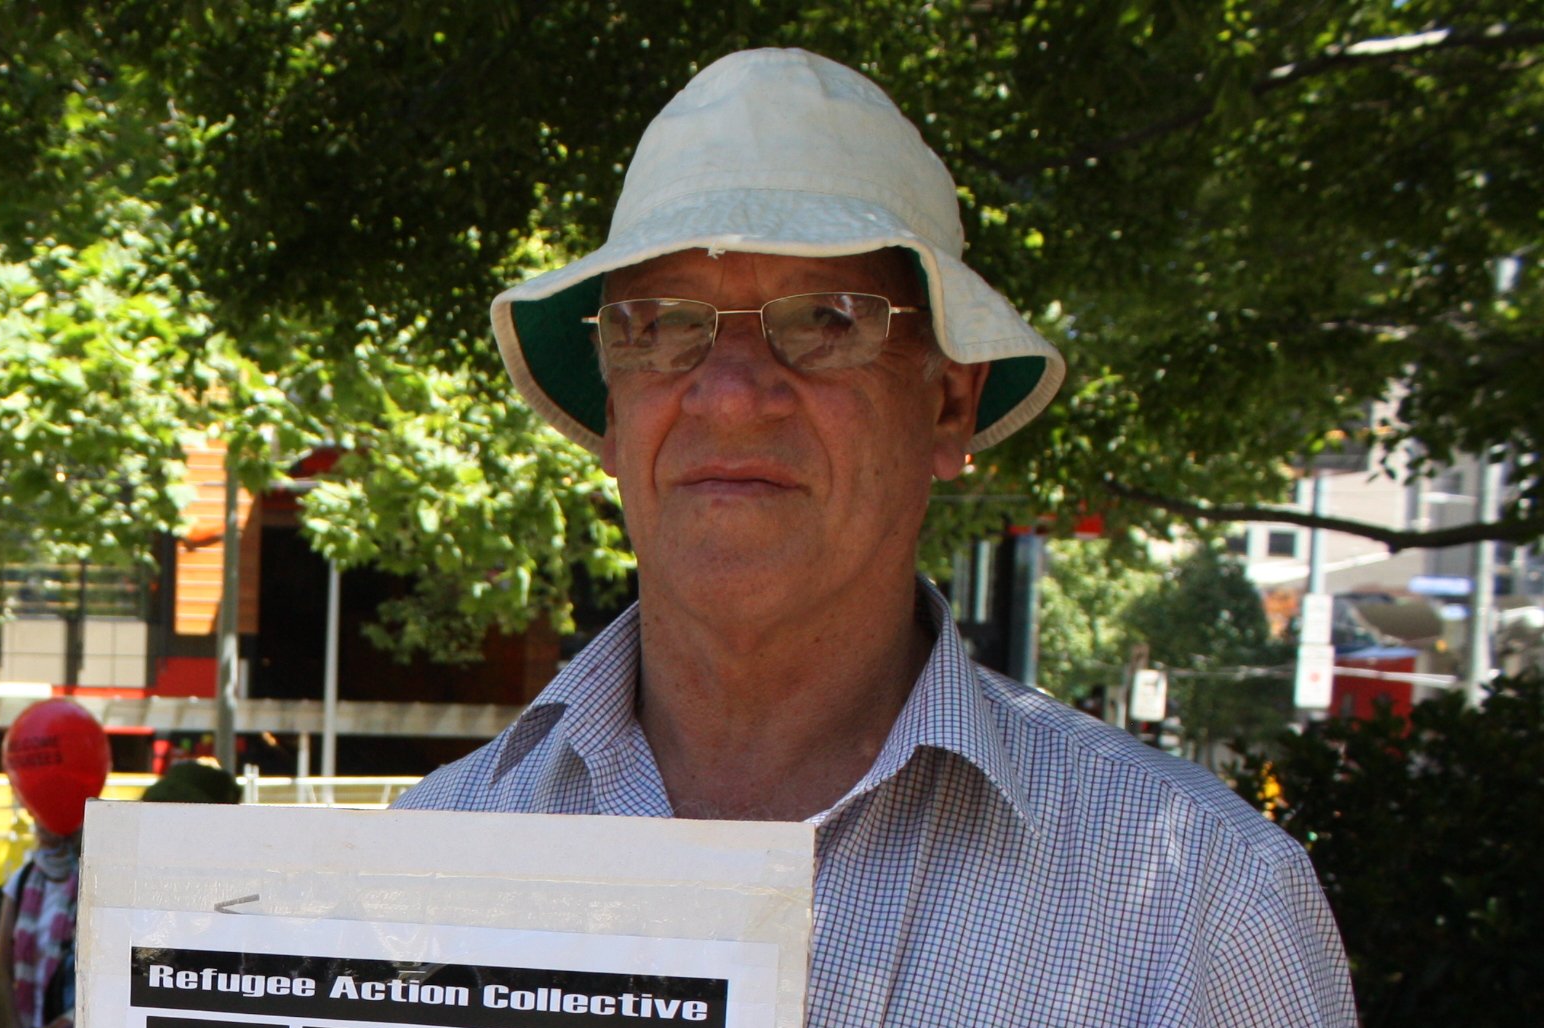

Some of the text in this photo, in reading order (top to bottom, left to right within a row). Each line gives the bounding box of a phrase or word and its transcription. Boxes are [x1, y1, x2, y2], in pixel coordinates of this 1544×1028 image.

[148, 964, 708, 1021] Refugee Action Collective
